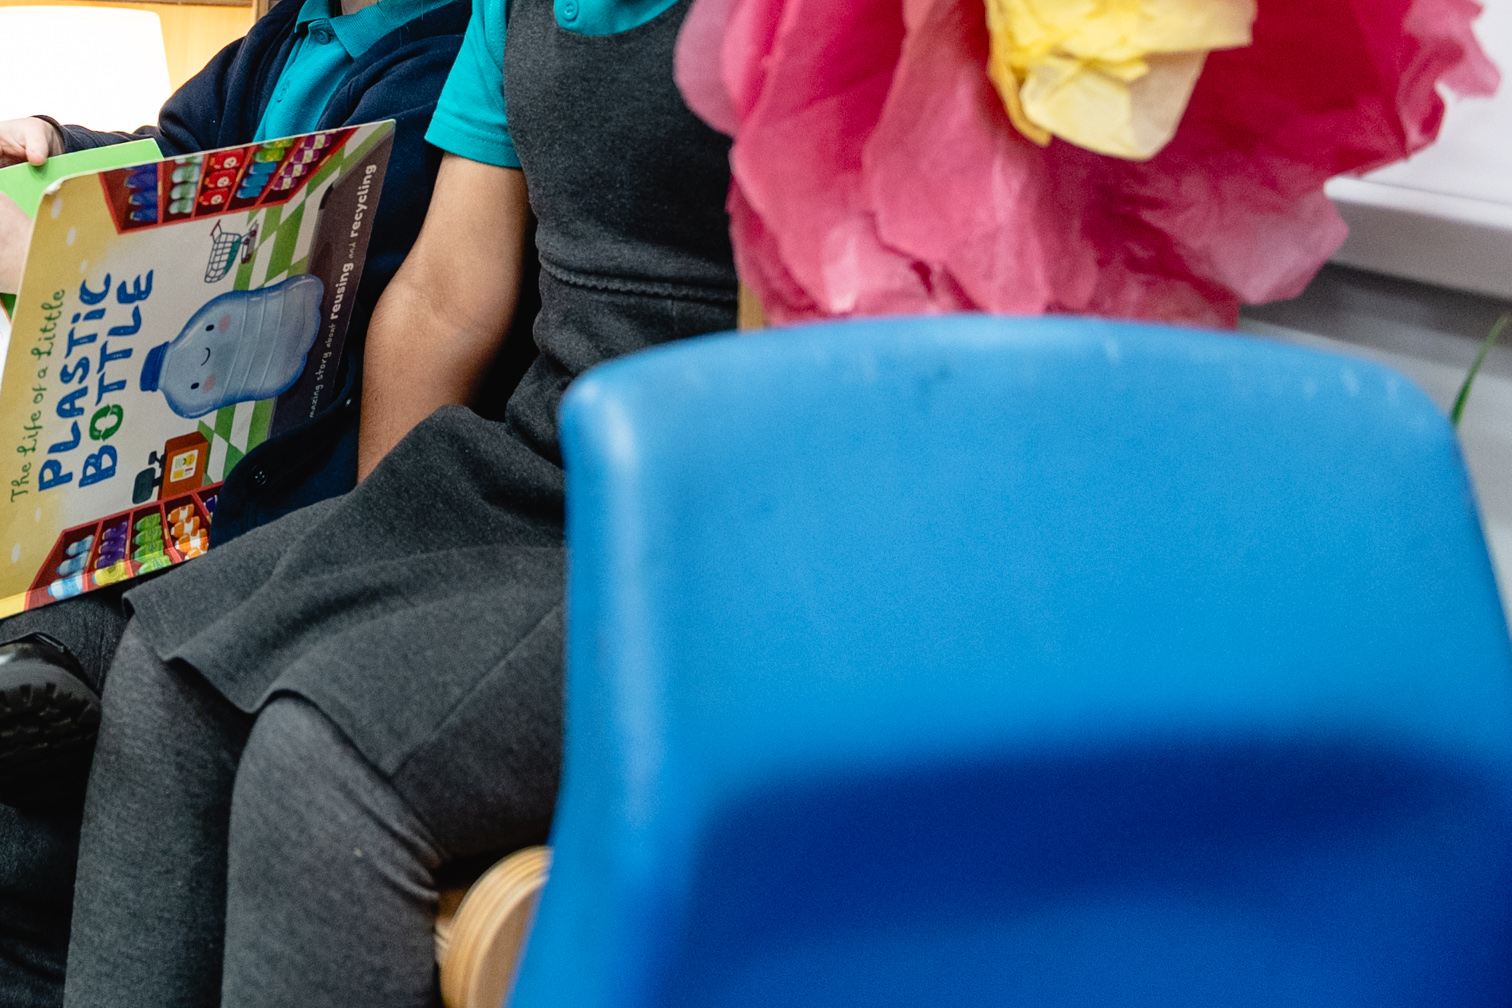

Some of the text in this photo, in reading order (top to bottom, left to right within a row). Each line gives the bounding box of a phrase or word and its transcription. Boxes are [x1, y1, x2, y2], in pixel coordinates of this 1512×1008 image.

[10, 288, 66, 504] The Life of a Little
[78, 269, 155, 489] BOTTLE
[309, 163, 378, 418] mazing story about reusing and recycling
